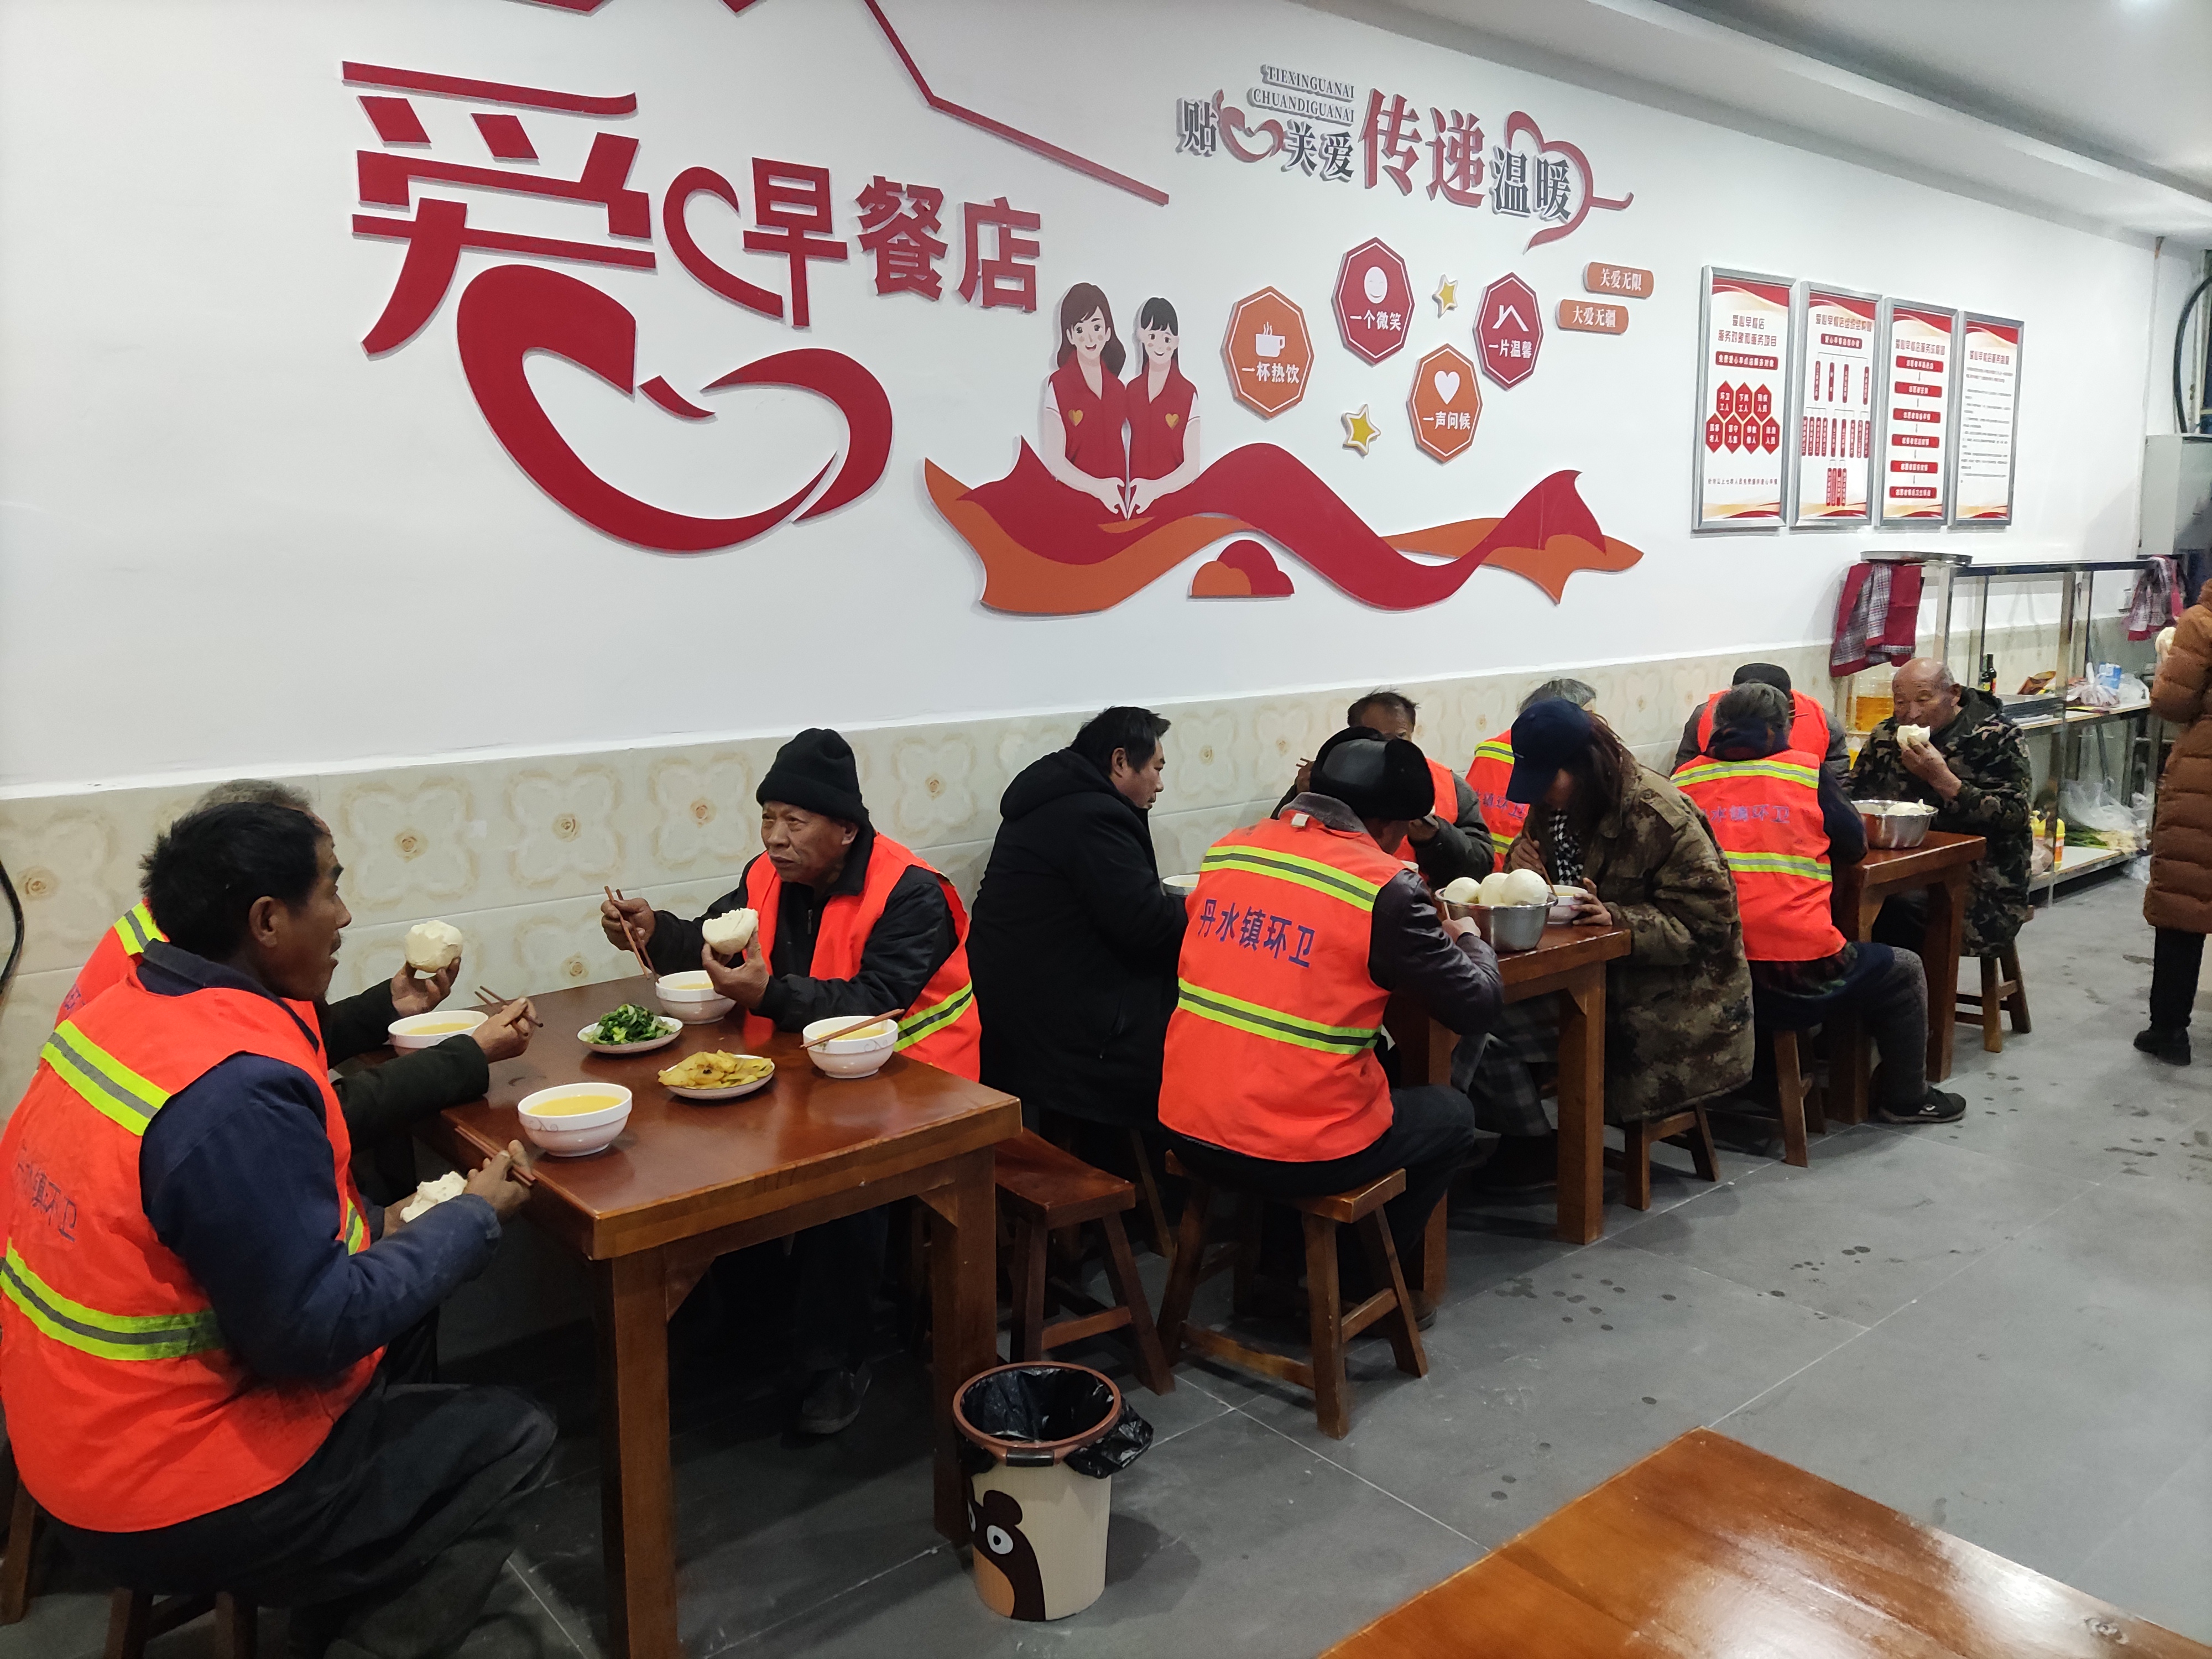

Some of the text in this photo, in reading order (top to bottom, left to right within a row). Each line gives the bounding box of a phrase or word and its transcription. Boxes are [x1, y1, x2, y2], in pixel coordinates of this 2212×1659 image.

[1267, 66, 1354, 98] TIEXINGUANAI
[1253, 88, 1354, 122] CHUANDIGUANAI
[1600, 268, 1642, 291] 关爱无限
[1350, 309, 1402, 331] 一个微笑
[1572, 305, 1616, 328] 大爱无疆
[1488, 338, 1532, 359] 一片温馨
[1241, 361, 1300, 384] 一杯热饮
[1422, 411, 1471, 431] 一声问候
[1197, 898, 1316, 968] 丹水镇环卫
